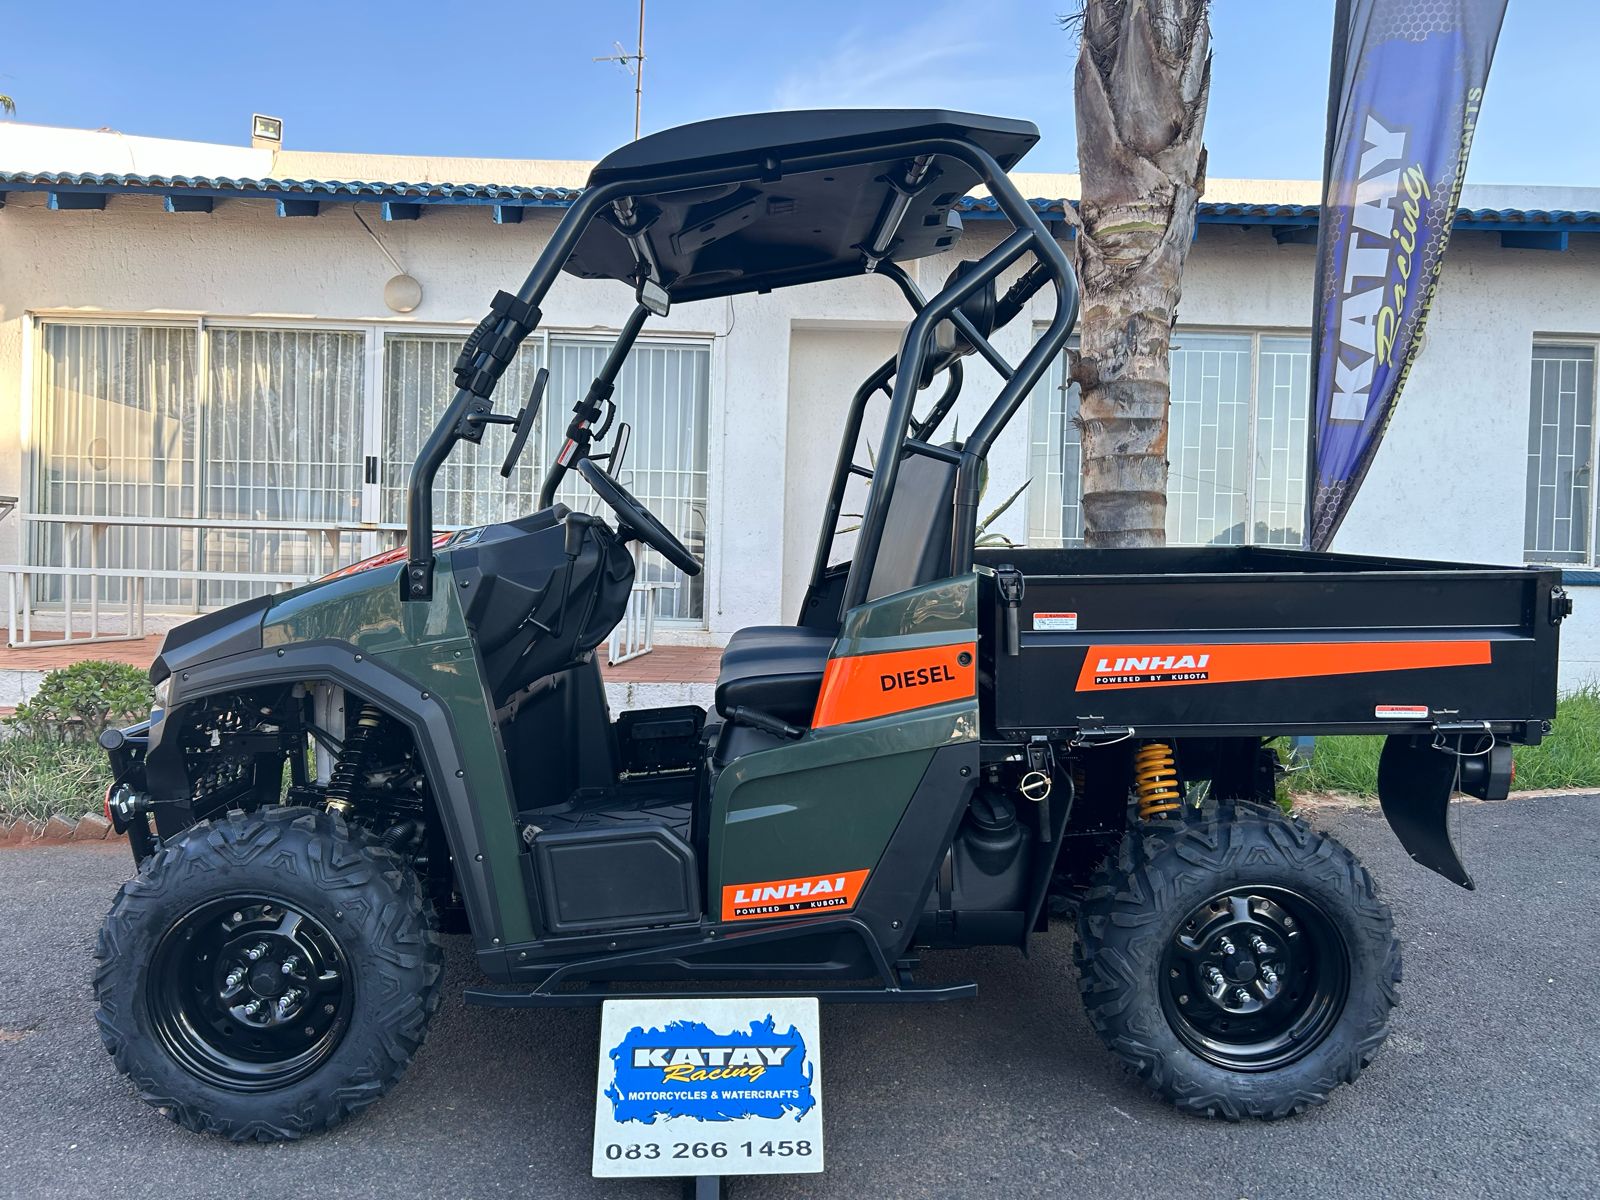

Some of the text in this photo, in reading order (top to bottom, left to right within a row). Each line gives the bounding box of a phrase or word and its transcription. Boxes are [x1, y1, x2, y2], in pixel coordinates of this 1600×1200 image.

[1437, 87, 1482, 255] WATERCRAFTS
[1330, 115, 1406, 421] KATAY
[1375, 163, 1431, 368] Racing
[1095, 654, 1210, 673] LINHAI
[880, 665, 955, 691] DIESEL
[1096, 676, 1141, 684] POWERED
[734, 877, 845, 904] LINHAI
[736, 906, 780, 915] POWERED
[810, 898, 846, 908] KUBOTA
[634, 1047, 792, 1067] KATAY
[662, 1063, 767, 1084] Racing
[628, 1089, 800, 1101] MOTORCYCLES & WATERCRAFTS
[605, 1140, 813, 1160] 083 266 1458
